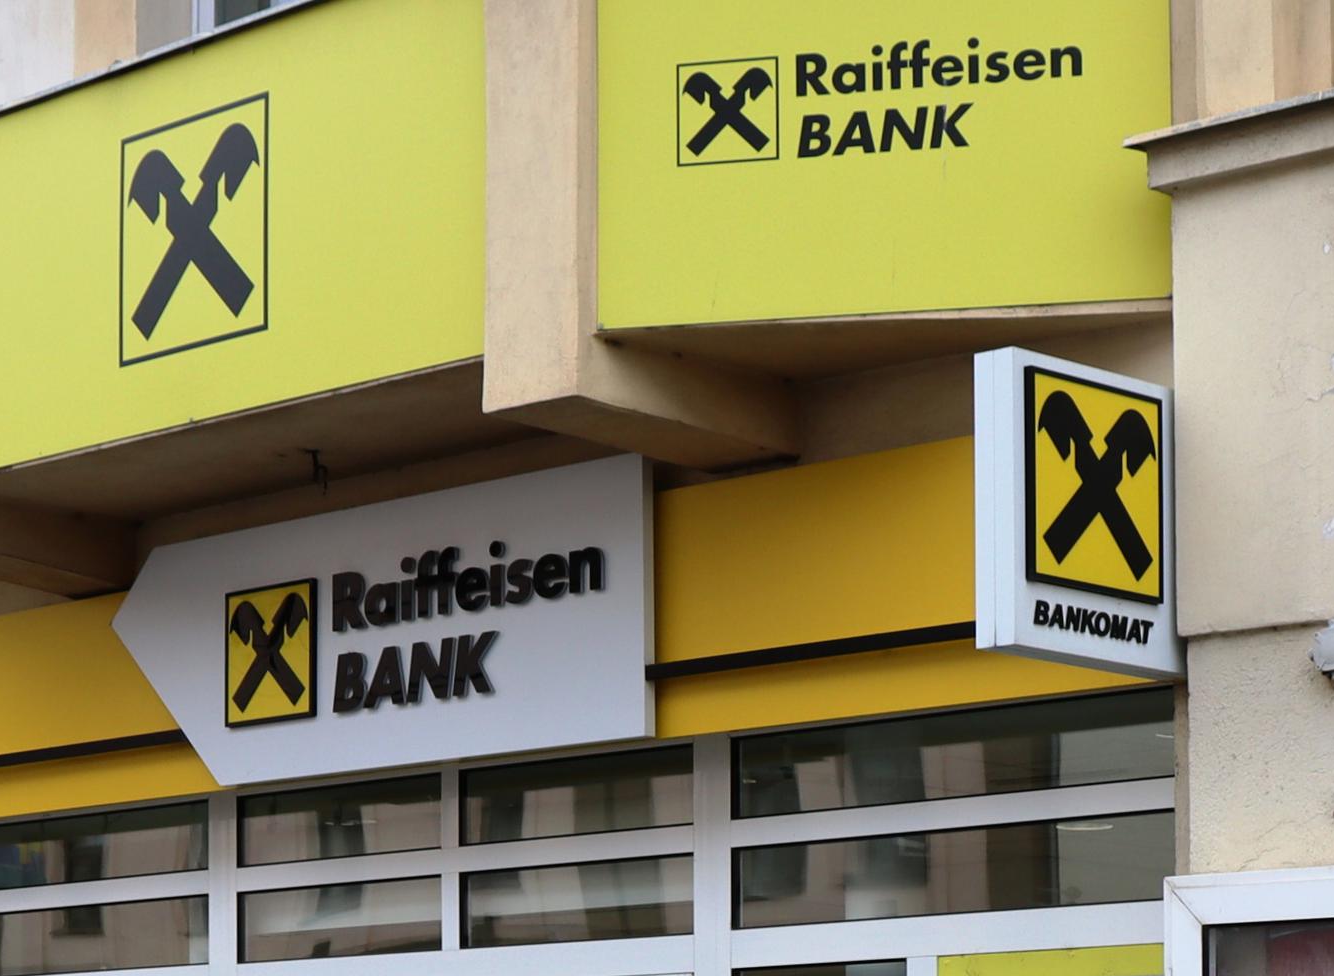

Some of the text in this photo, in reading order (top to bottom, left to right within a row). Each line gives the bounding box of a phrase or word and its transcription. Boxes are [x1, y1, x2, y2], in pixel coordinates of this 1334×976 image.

[796, 37, 1083, 97] Raiffeisen
[797, 103, 974, 158] BANK
[332, 541, 605, 632] Raiffeisen
[1033, 599, 1154, 645] BANKOMAT
[333, 630, 499, 713] BANK
